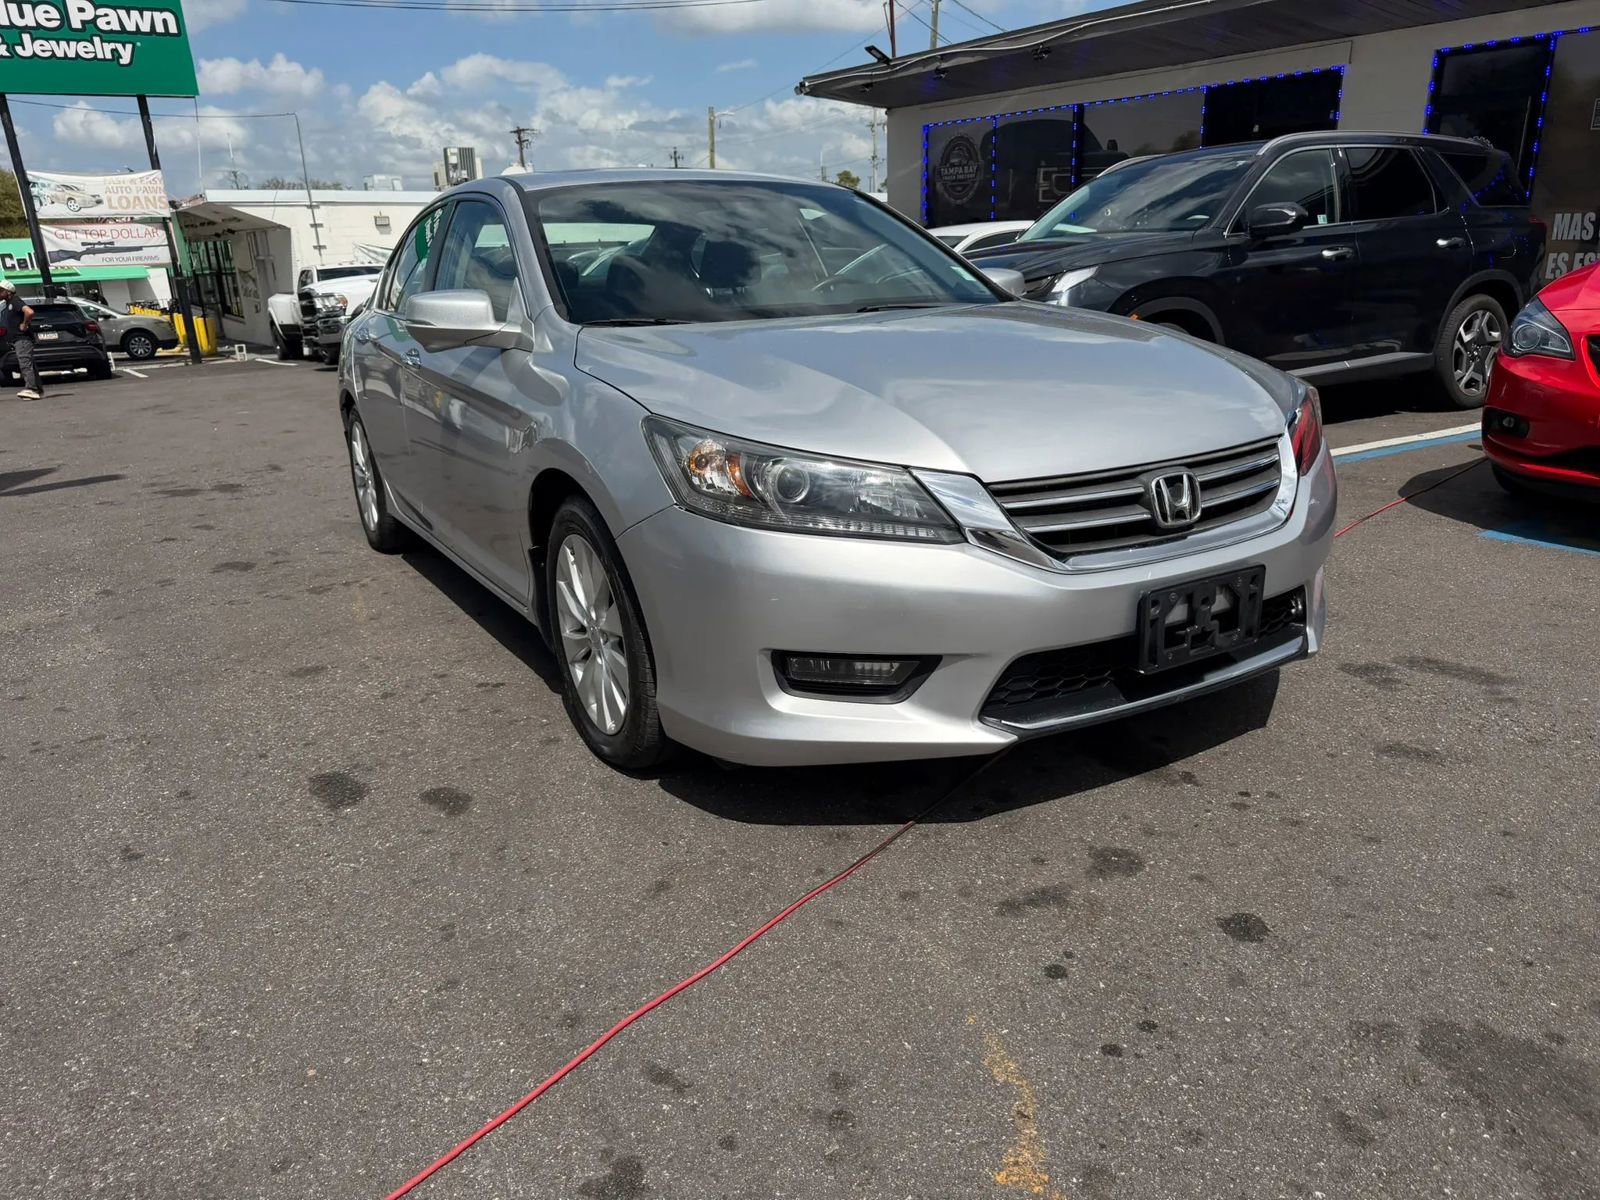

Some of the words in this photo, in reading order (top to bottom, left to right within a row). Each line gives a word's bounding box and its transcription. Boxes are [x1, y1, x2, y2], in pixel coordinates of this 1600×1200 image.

[65, 0, 179, 34] Pawn
[14, 32, 133, 65] Jewelry
[105, 185, 132, 194] AUTO
[106, 195, 169, 210] LOANS
[54, 229, 80, 240] GET
[81, 228, 108, 239] TOP
[110, 227, 160, 240] DOLLAR
[1551, 211, 1596, 241] MAS
[1545, 252, 1569, 279] ES
